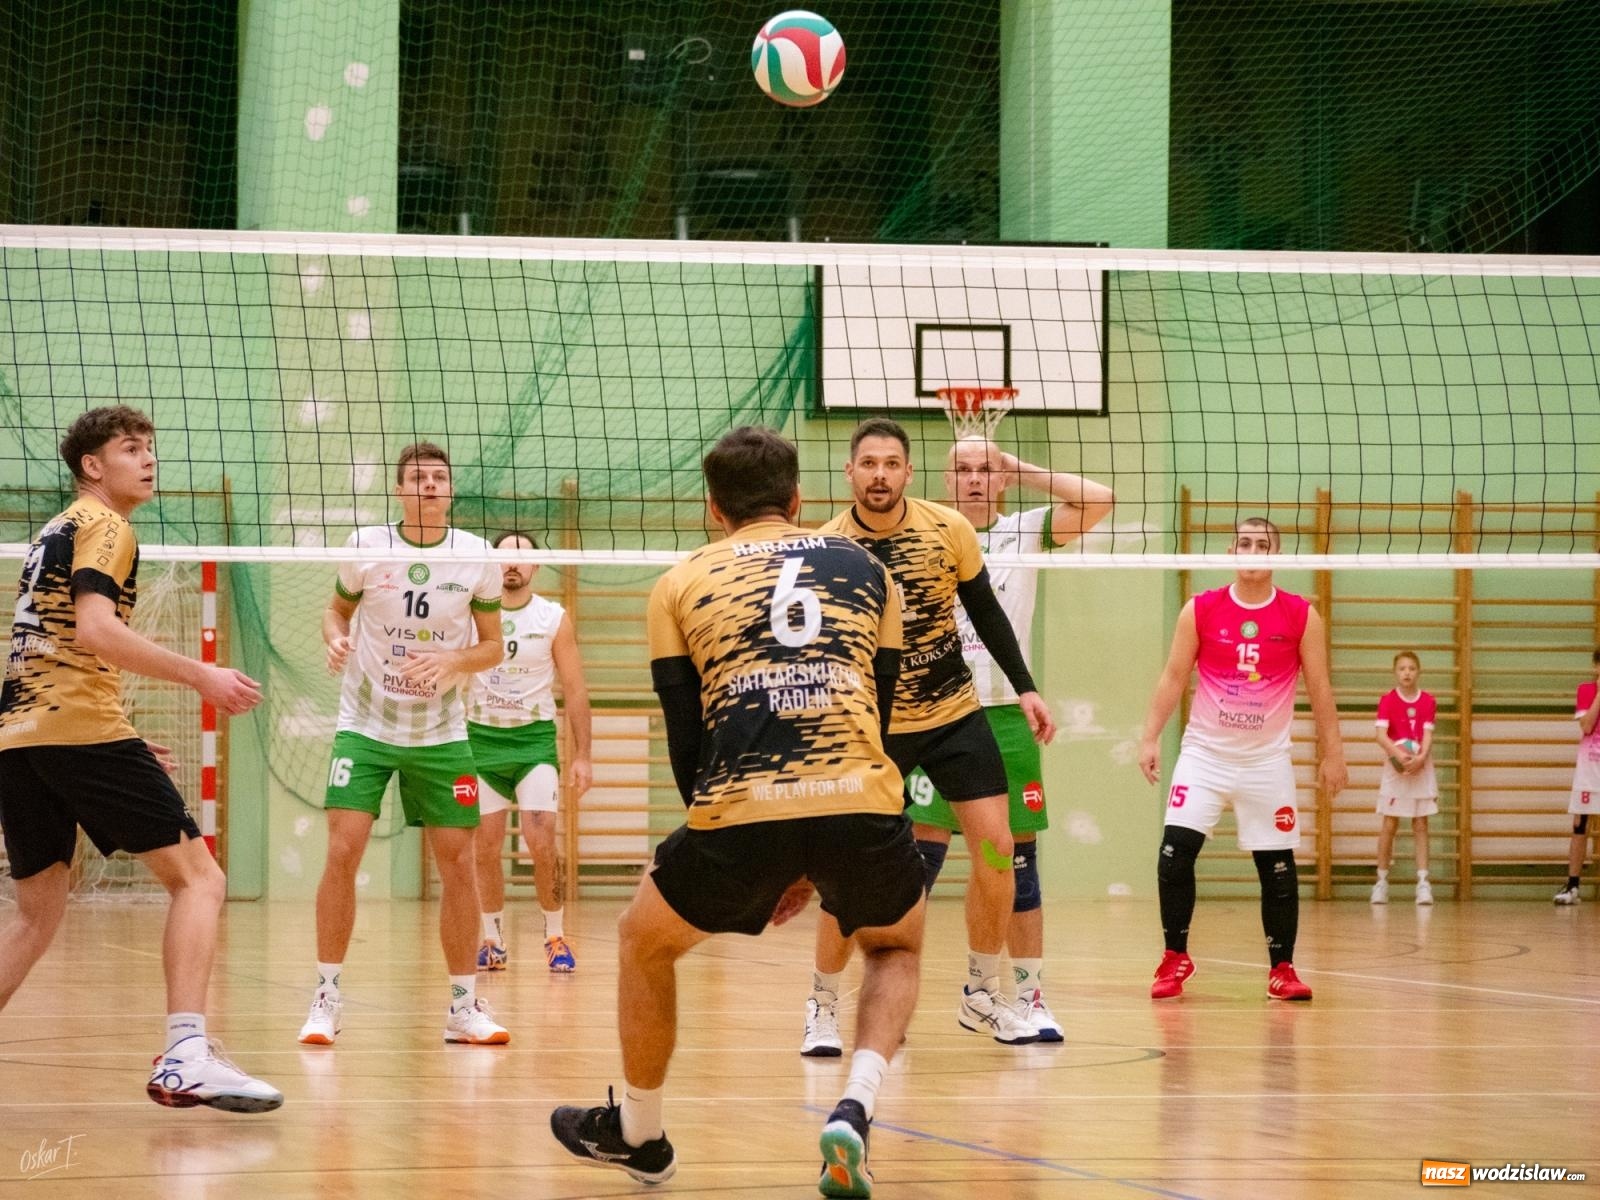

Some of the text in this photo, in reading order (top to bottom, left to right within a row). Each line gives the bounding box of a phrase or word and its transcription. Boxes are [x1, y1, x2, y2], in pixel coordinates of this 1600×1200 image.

[731, 536, 828, 557] HARAZIM
[403, 590, 429, 619] 16
[770, 557, 823, 648] 6
[1235, 642, 1261, 666] 15
[383, 684, 436, 699] TECHNOLOGY
[769, 687, 833, 712] RADLIN
[1218, 709, 1265, 724] PIVEXIN
[329, 758, 354, 787] 16
[752, 777, 864, 801] WE PLAY FOR FUN
[910, 773, 935, 807] 19
